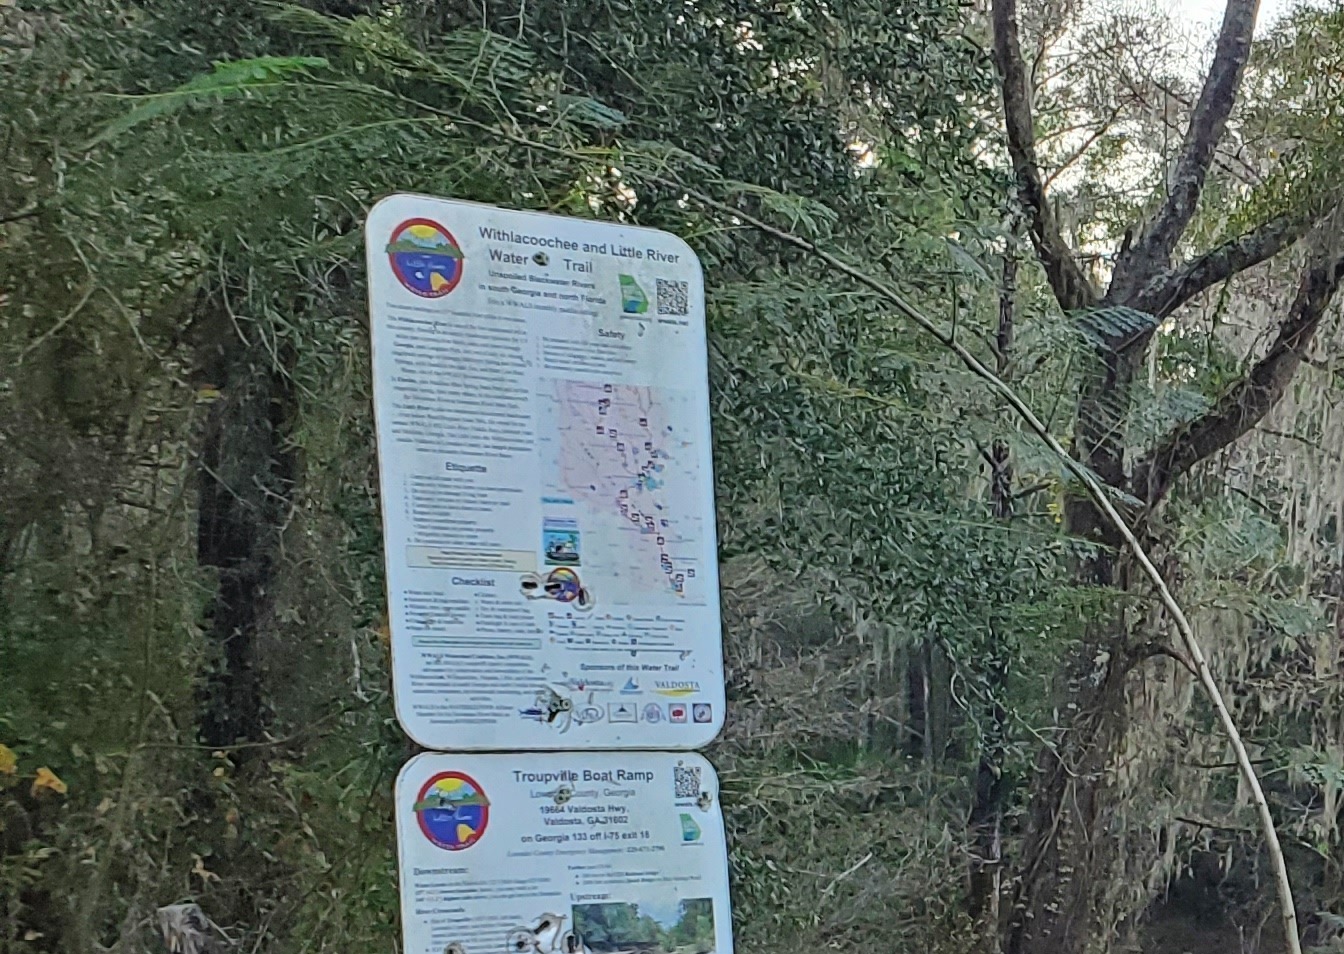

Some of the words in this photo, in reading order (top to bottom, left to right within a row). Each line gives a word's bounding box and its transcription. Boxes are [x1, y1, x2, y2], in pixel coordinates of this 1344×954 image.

[479, 226, 578, 251] Withlacoochee
[582, 243, 606, 254] and
[610, 244, 643, 258] Little
[647, 249, 680, 263] River
[489, 249, 529, 265] Water
[563, 259, 593, 273] Trail
[598, 328, 625, 340] Safety
[445, 461, 487, 473] Etiquette
[451, 577, 495, 586] Checklist
[654, 680, 700, 689] VALDOSTA
[513, 770, 578, 784] Troupville
[583, 770, 613, 781] Boat
[617, 769, 654, 782] Ramp
[567, 805, 606, 813] Valdosta
[607, 804, 630, 813] Hwy.
[535, 834, 569, 843] Georgia
[590, 832, 602, 840] off
[622, 831, 638, 839] exit
